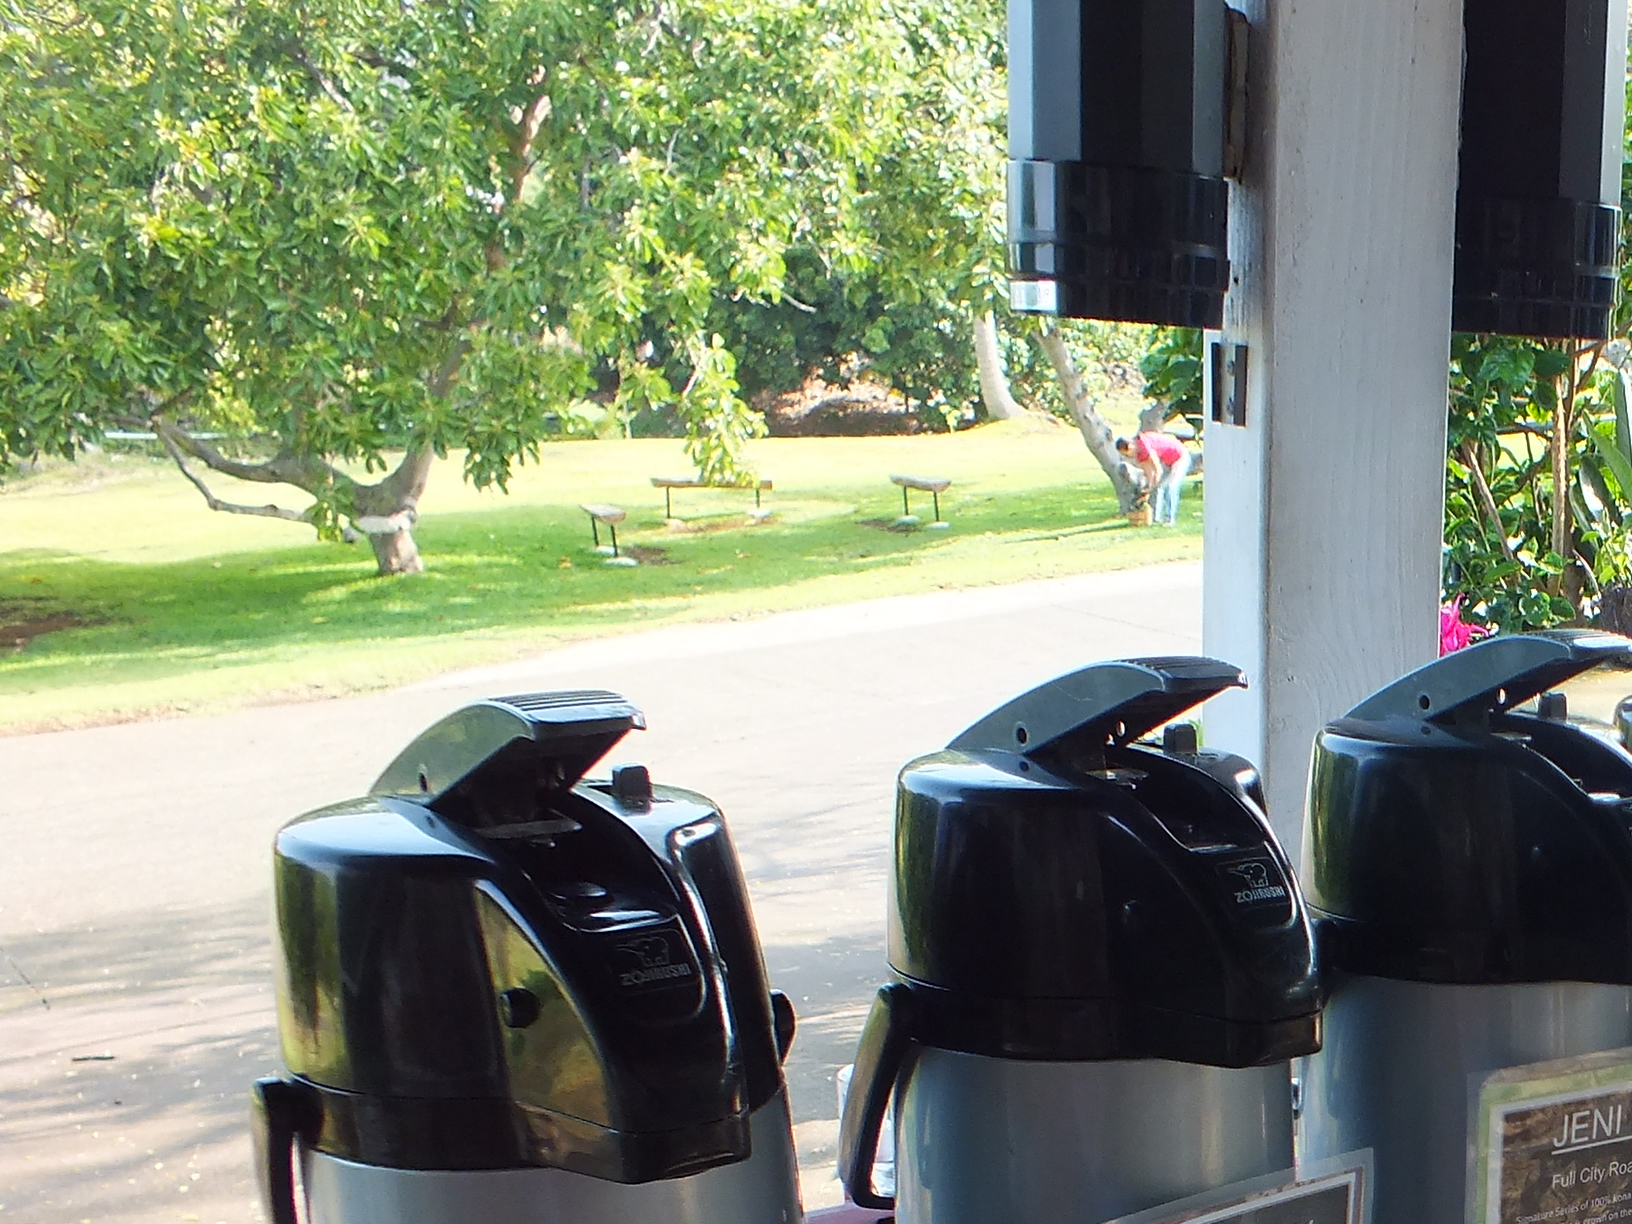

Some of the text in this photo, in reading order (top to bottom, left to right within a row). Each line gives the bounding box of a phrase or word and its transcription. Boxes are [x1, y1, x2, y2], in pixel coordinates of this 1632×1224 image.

[1555, 1105, 1621, 1148] JENI
[1552, 1171, 1575, 1189] Full
[1580, 1168, 1605, 1183] City
[1580, 1201, 1588, 1210] of
[1620, 1209, 1632, 1217] the
